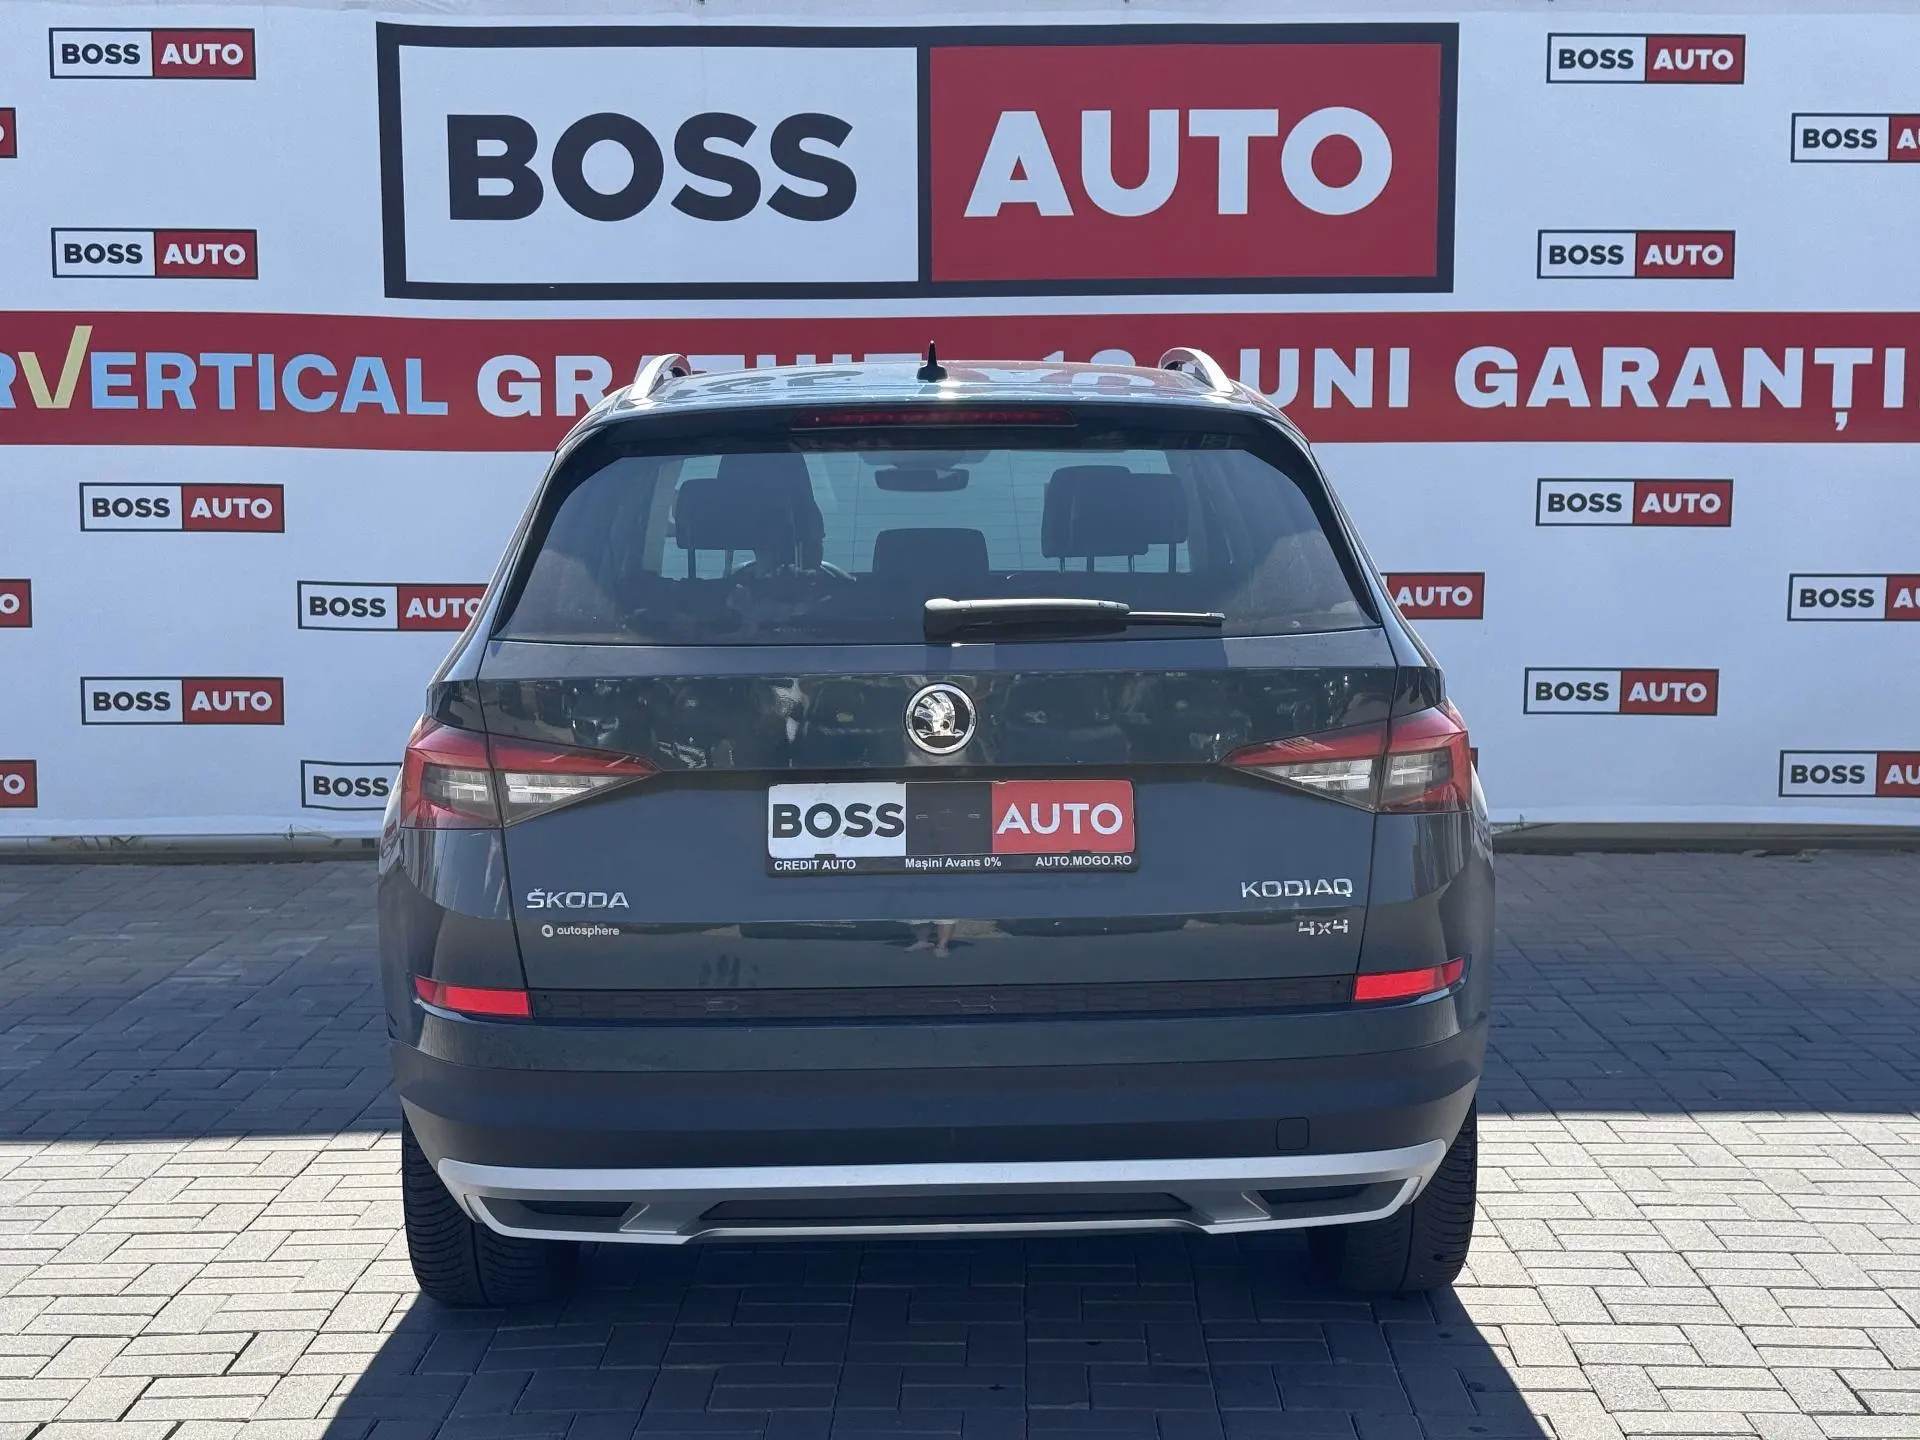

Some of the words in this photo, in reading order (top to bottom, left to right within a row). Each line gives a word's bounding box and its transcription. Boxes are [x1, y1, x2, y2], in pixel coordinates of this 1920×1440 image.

[61, 43, 141, 65] BOSS
[161, 43, 244, 66] AUTO
[1558, 48, 1634, 70] BOSS
[1653, 48, 1734, 71] AUTO
[1802, 128, 1878, 149] BOSS
[447, 112, 857, 222] BOSS
[964, 106, 1393, 217] AUTO
[63, 243, 143, 265] BOSS
[163, 243, 246, 266] AUTO
[1549, 244, 1625, 266] BOSS
[1643, 244, 1724, 266] AUTO
[1182, 347, 1410, 412] UNI
[1455, 346, 1920, 431] GARANȚI
[92, 497, 171, 518] BOSS
[191, 497, 273, 519] AUTO
[1547, 492, 1623, 513] BOSS
[1640, 492, 1722, 514] AUTO
[309, 596, 387, 618] BOSS
[1395, 586, 1473, 607] AUTO
[1799, 588, 1875, 609] BOSS
[93, 691, 171, 712] BOSS
[192, 690, 273, 712] AUTO
[1535, 681, 1610, 702] BOSS
[1628, 681, 1707, 703] AUTO
[1790, 764, 1866, 785] BOSS
[1884, 764, 1920, 785] AU
[313, 775, 390, 798] BOSS
[772, 803, 905, 839] BOSS
[996, 803, 1123, 835] AUTO
[774, 859, 820, 871] CREDIT
[822, 859, 857, 870] AUTO
[945, 857, 981, 868] Avans
[984, 856, 1002, 867] 0%
[1035, 855, 1132, 867] AUTO.MOGO.RO
[526, 888, 630, 909] ŠKODA
[1240, 878, 1353, 898] KODIAQ
[556, 924, 620, 938] autosphere
